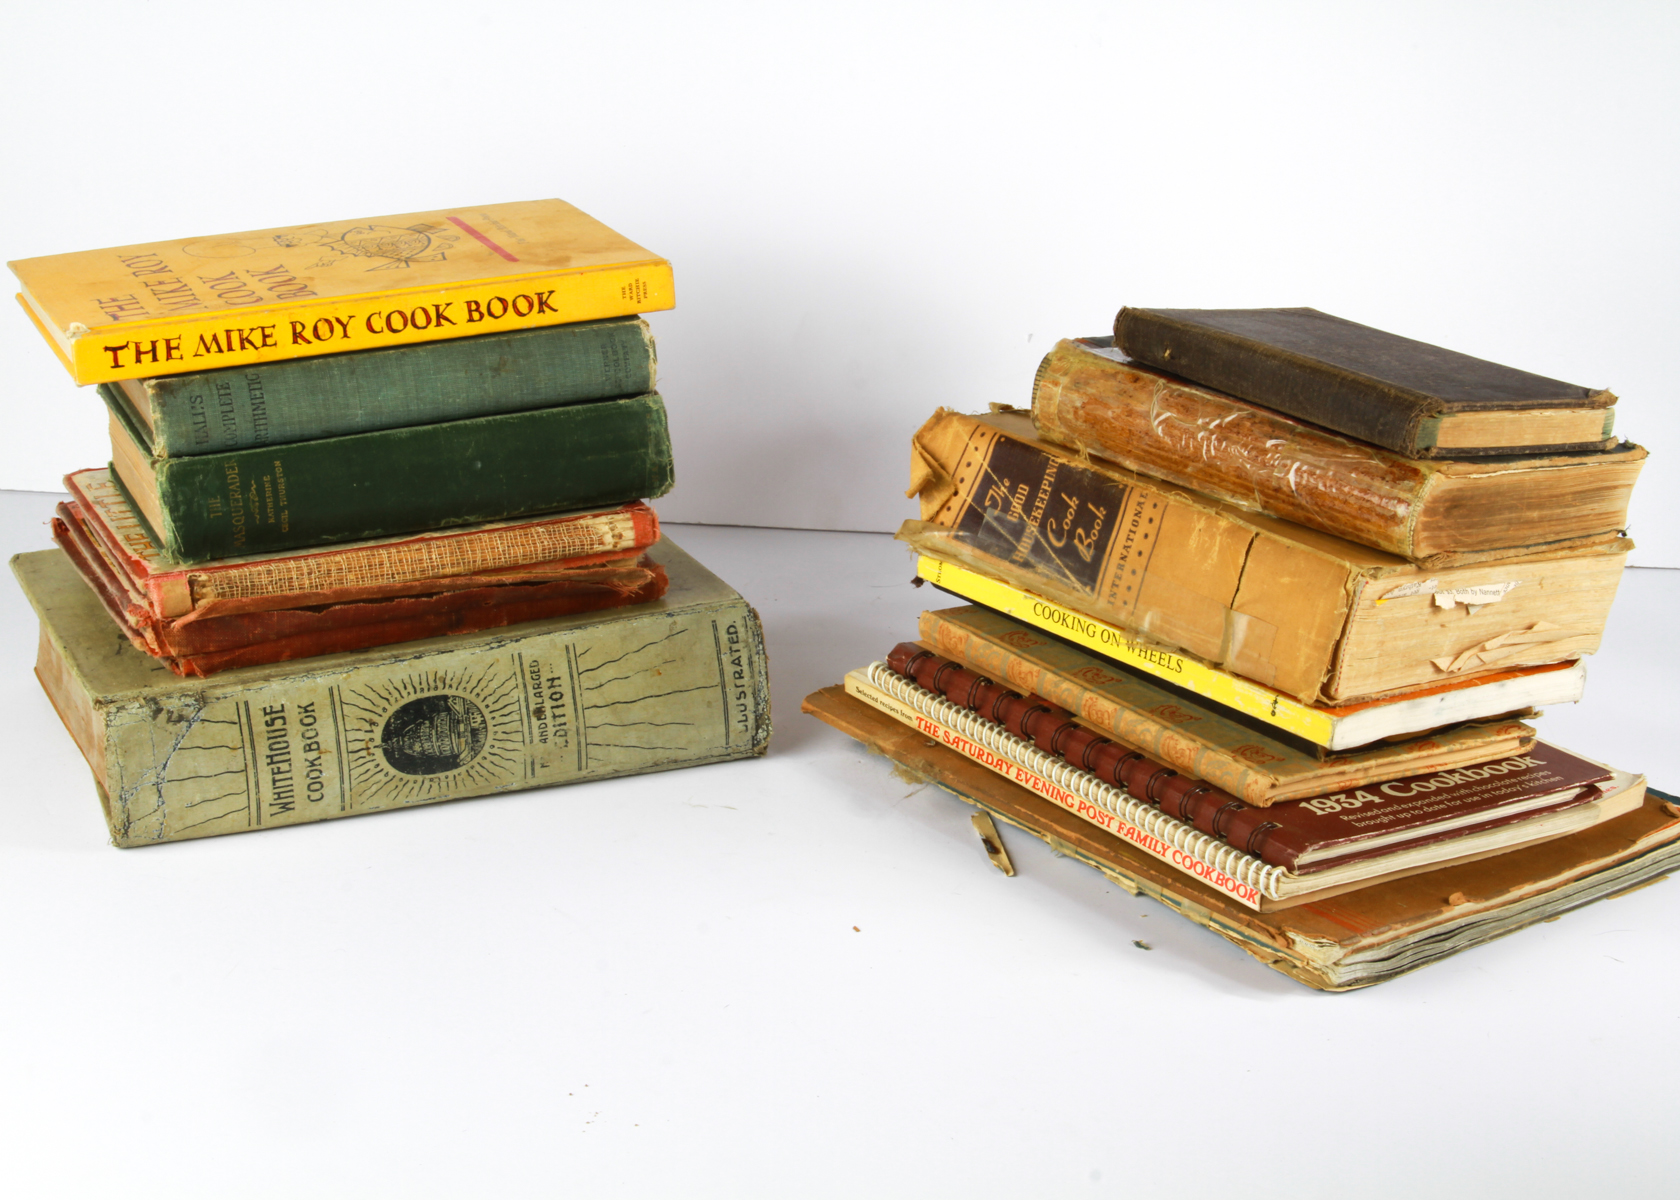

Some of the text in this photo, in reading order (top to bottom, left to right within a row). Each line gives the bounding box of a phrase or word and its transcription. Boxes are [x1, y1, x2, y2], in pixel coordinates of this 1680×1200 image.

[117, 253, 174, 278] ROY
[197, 271, 264, 306] COOK
[244, 264, 319, 300] BOOK
[96, 294, 151, 322] THE
[103, 290, 559, 369] THE MIKE ROY COOK BOOK
[190, 395, 209, 445] HALL'S
[216, 381, 238, 447] COMPLETE
[245, 373, 269, 445] ARITHMETIC
[208, 495, 223, 519] THE
[224, 459, 246, 548] MASQUERADER
[263, 475, 276, 524] KATHERINE
[274, 461, 289, 533] CECIL THURSTON
[985, 478, 1010, 515] The
[1006, 483, 1029, 522] GOOD
[1012, 454, 1061, 563] HOUSEKEEPING
[1047, 491, 1079, 548] Cook
[124, 533, 161, 562] THE
[1074, 502, 1107, 563] Book
[1107, 491, 1149, 606] INTERNATIONAL
[1032, 601, 1184, 674] COOKING ON WHEELS
[726, 620, 749, 734] LLUSTRATED.
[297, 701, 324, 803] COOK BOOK
[537, 722, 548, 744] AND
[855, 686, 1260, 906] Selected recipes from THE SATURDAY EVENING POST FAMILY COOKBOOK
[1299, 756, 1548, 816] 1934 Cookbook
[1339, 770, 1552, 822] Revised and expanded with chocolate recipes
[1351, 814, 1397, 828] brought
[1410, 807, 1424, 816] to
[1423, 803, 1448, 813] date
[1444, 799, 1465, 807] for
[1463, 796, 1481, 804] use
[1480, 792, 1492, 800] in
[1526, 775, 1564, 788] kitchen
